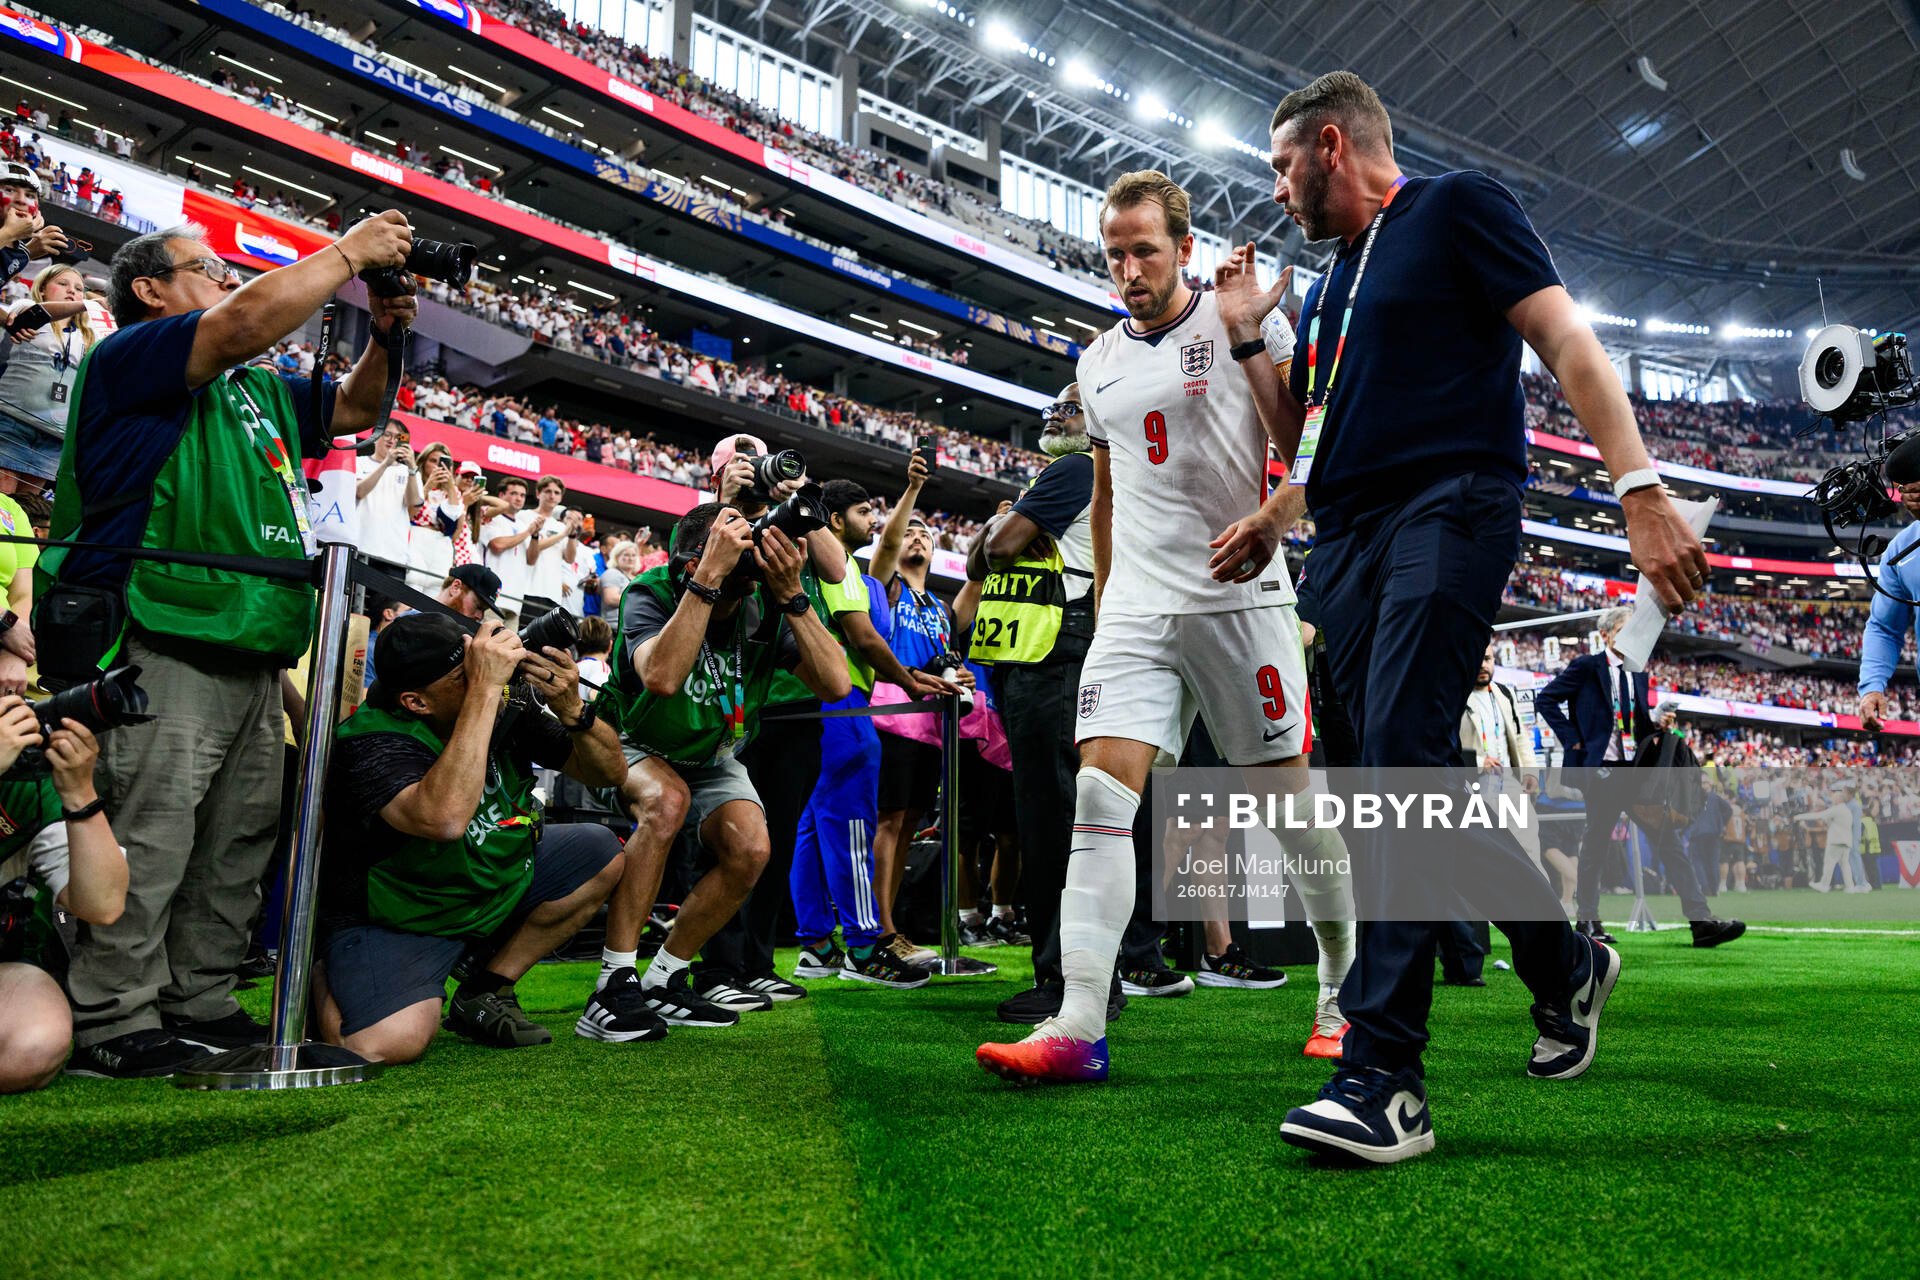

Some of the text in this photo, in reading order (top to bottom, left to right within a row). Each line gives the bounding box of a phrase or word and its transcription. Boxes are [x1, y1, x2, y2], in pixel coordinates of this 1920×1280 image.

[352, 53, 472, 117] DALLAS
[1372, 213, 1384, 228] FIFA
[1363, 228, 1378, 256] WORLD
[317, 325, 330, 365] SONY
[1183, 379, 1209, 389] CROATIA
[1143, 409, 1169, 465] 9
[487, 444, 541, 473] CROATIA
[970, 617, 1020, 649] 921
[712, 668, 722, 690] 2026
[1256, 664, 1287, 721] 9
